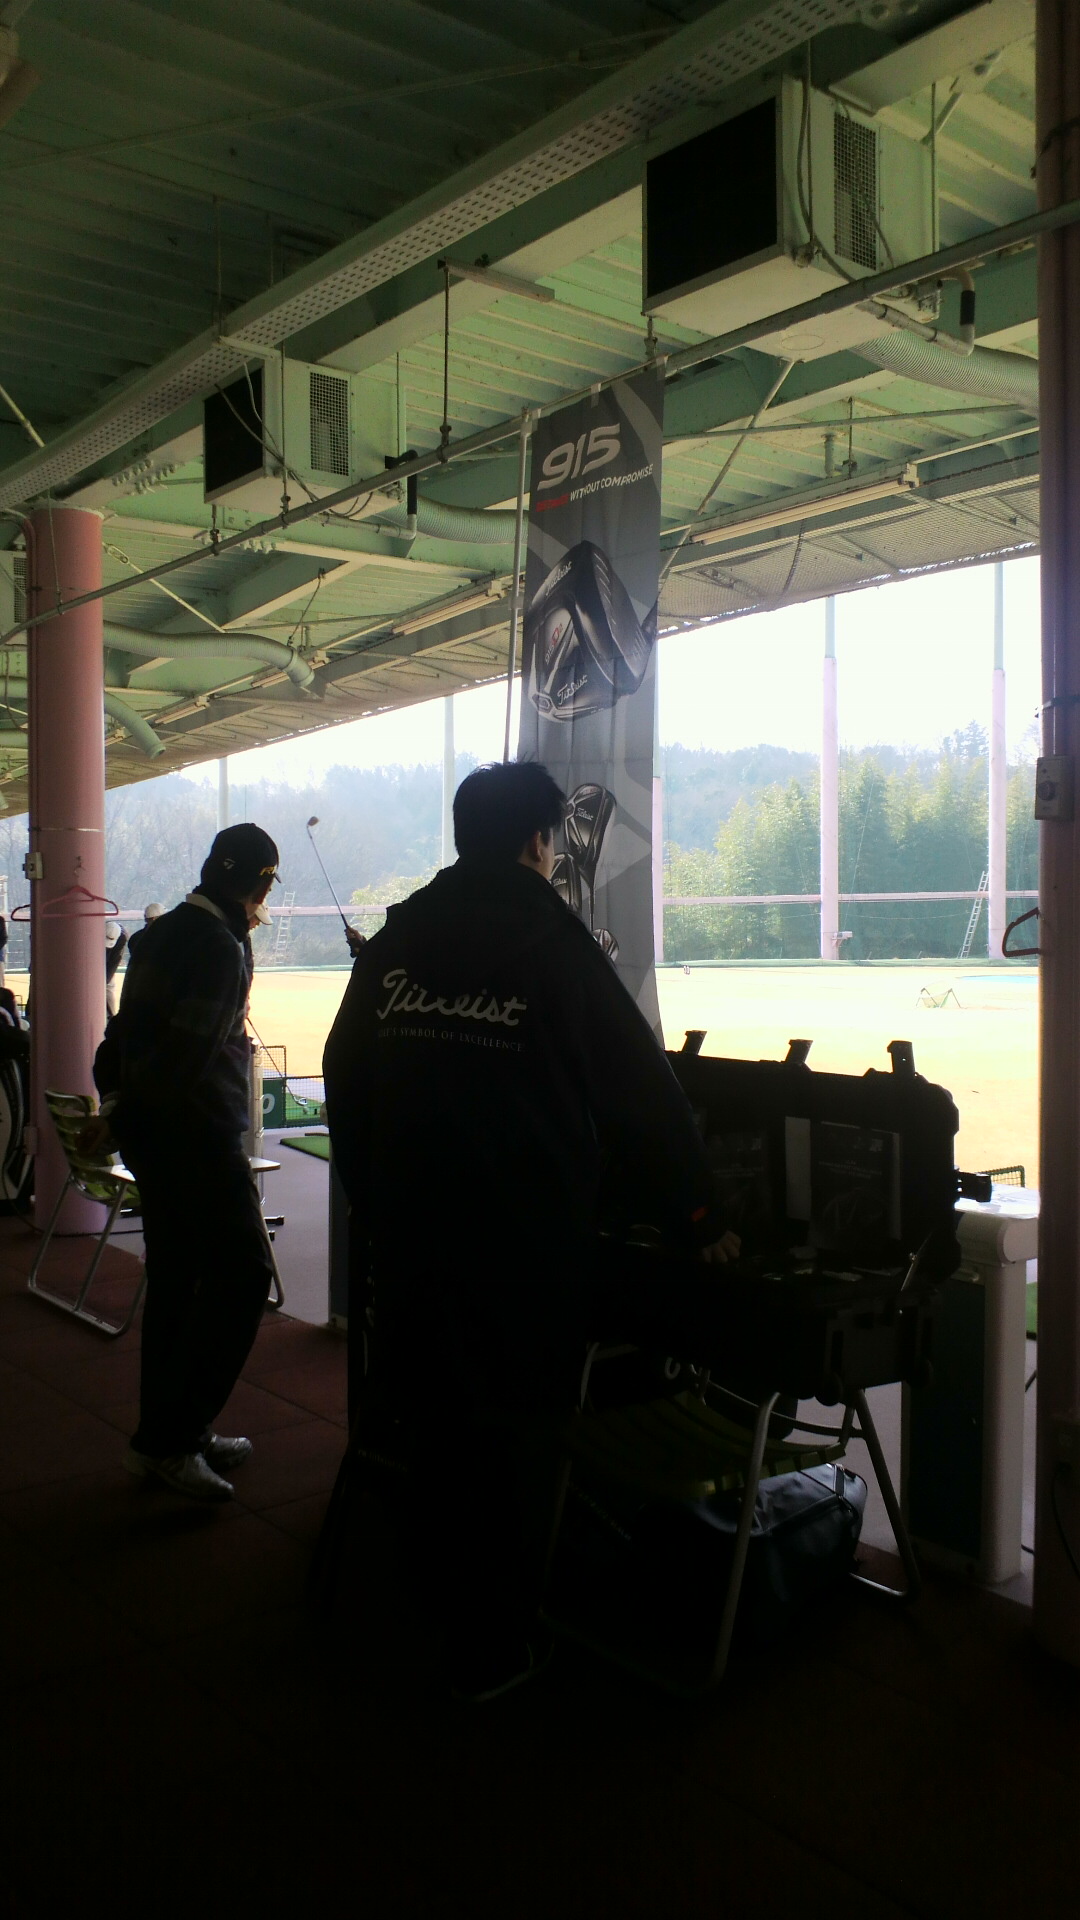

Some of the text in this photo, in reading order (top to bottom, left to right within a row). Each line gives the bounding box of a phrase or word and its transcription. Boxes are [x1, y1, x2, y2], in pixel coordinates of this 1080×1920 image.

[537, 422, 621, 491] 915
[600, 463, 654, 489] COMPROMISE
[400, 1027, 437, 1039] SYMBOL
[440, 1031, 455, 1041] OF
[459, 1032, 524, 1052] EXCELLENCE
